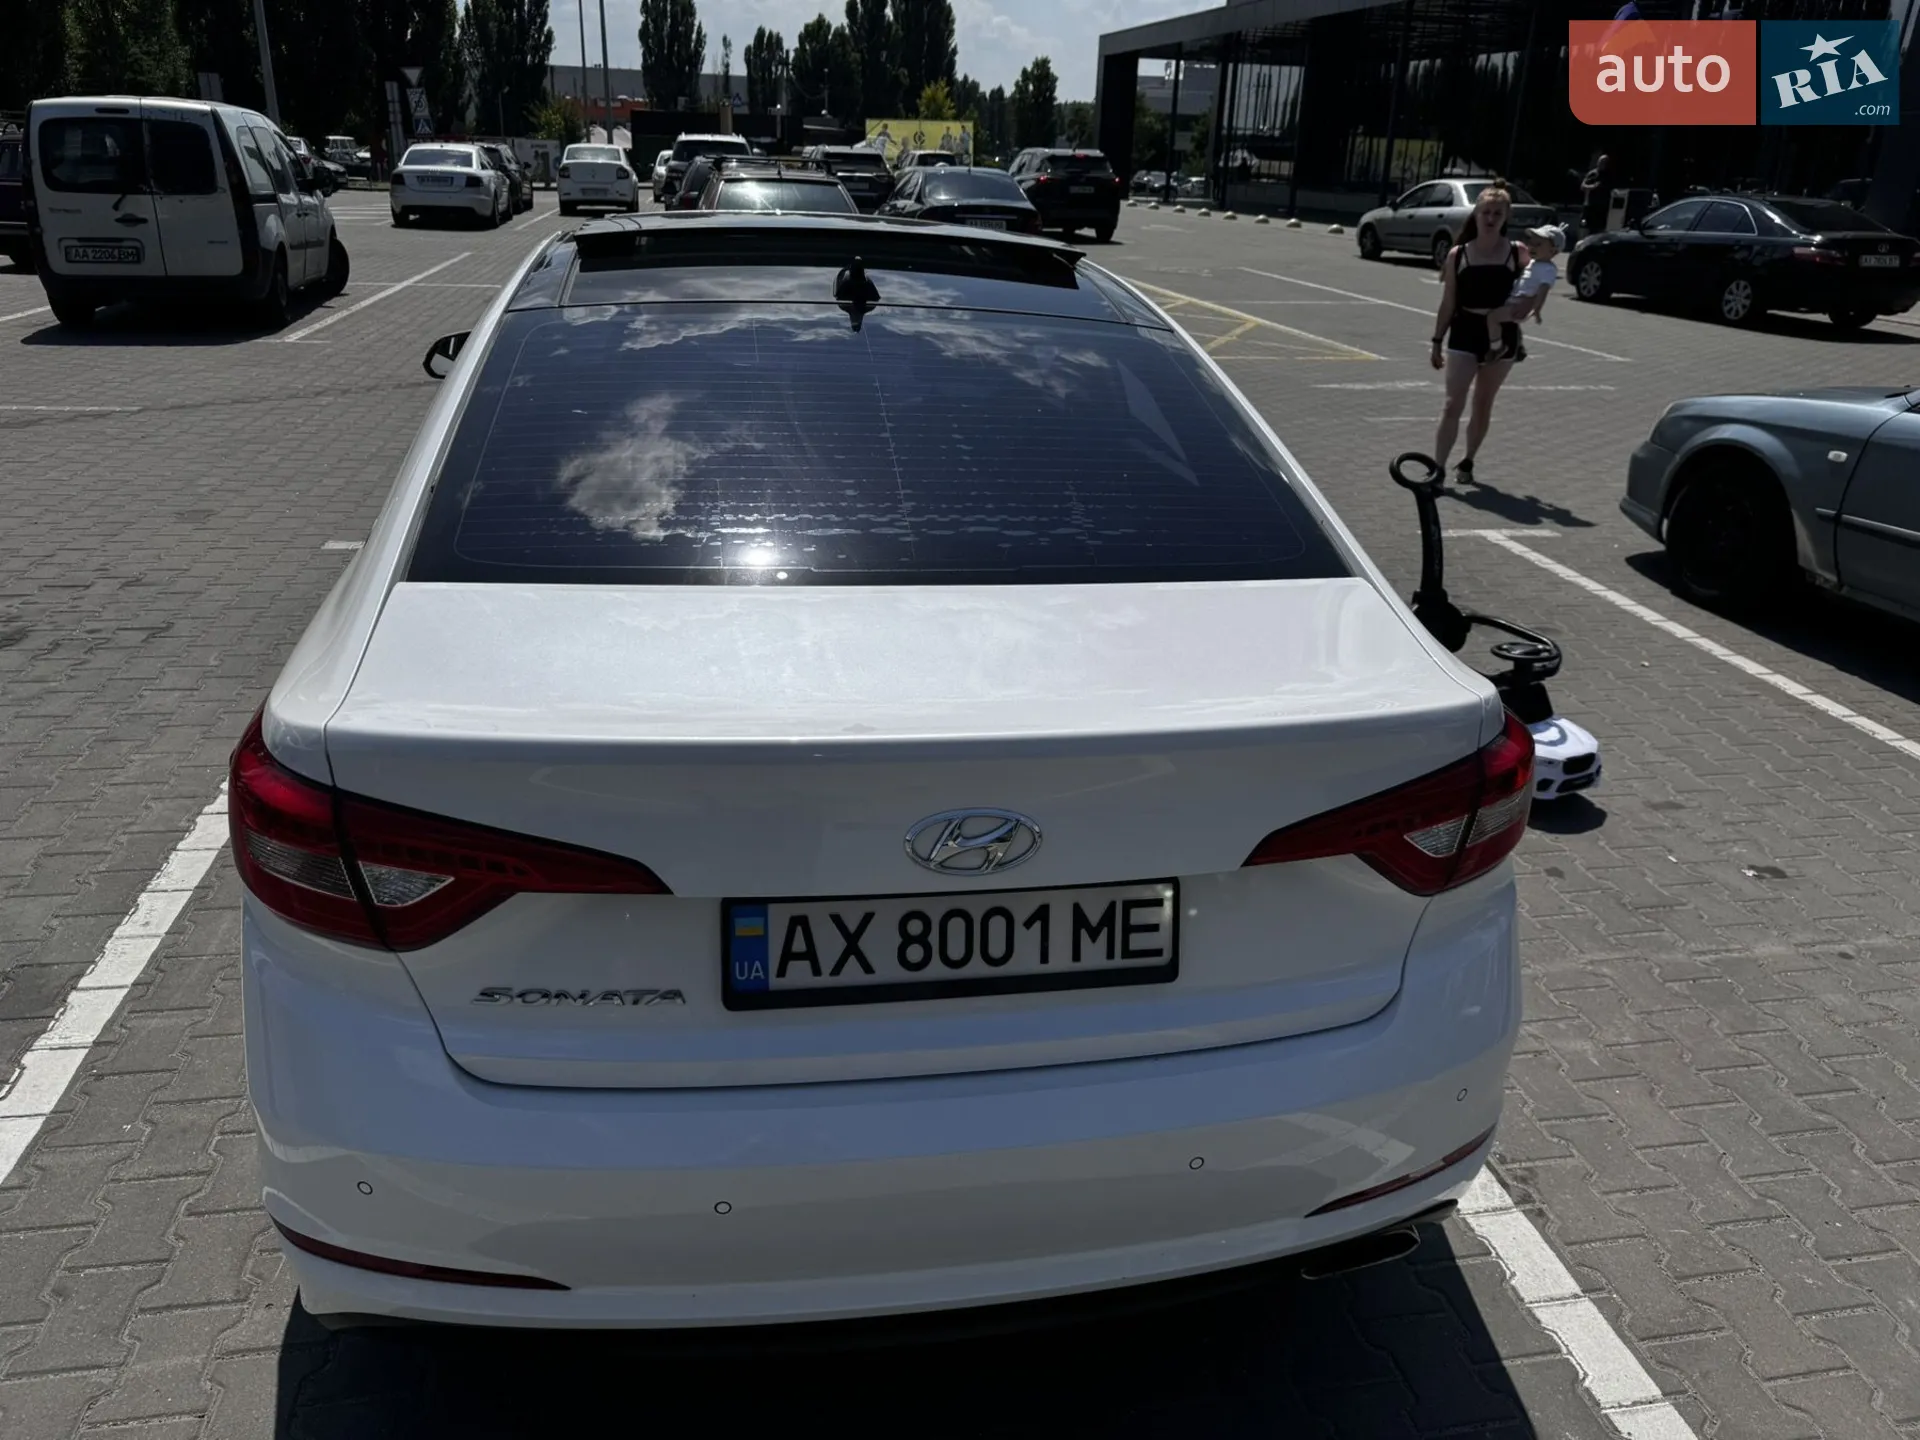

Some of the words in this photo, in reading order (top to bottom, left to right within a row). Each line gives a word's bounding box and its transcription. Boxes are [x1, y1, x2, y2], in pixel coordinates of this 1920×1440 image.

[74, 248, 89, 260] AA
[775, 911, 876, 978] AX
[897, 904, 1050, 972] 8001
[1071, 898, 1165, 963] ME
[734, 961, 766, 981] UA
[473, 986, 687, 1006] SONATA
